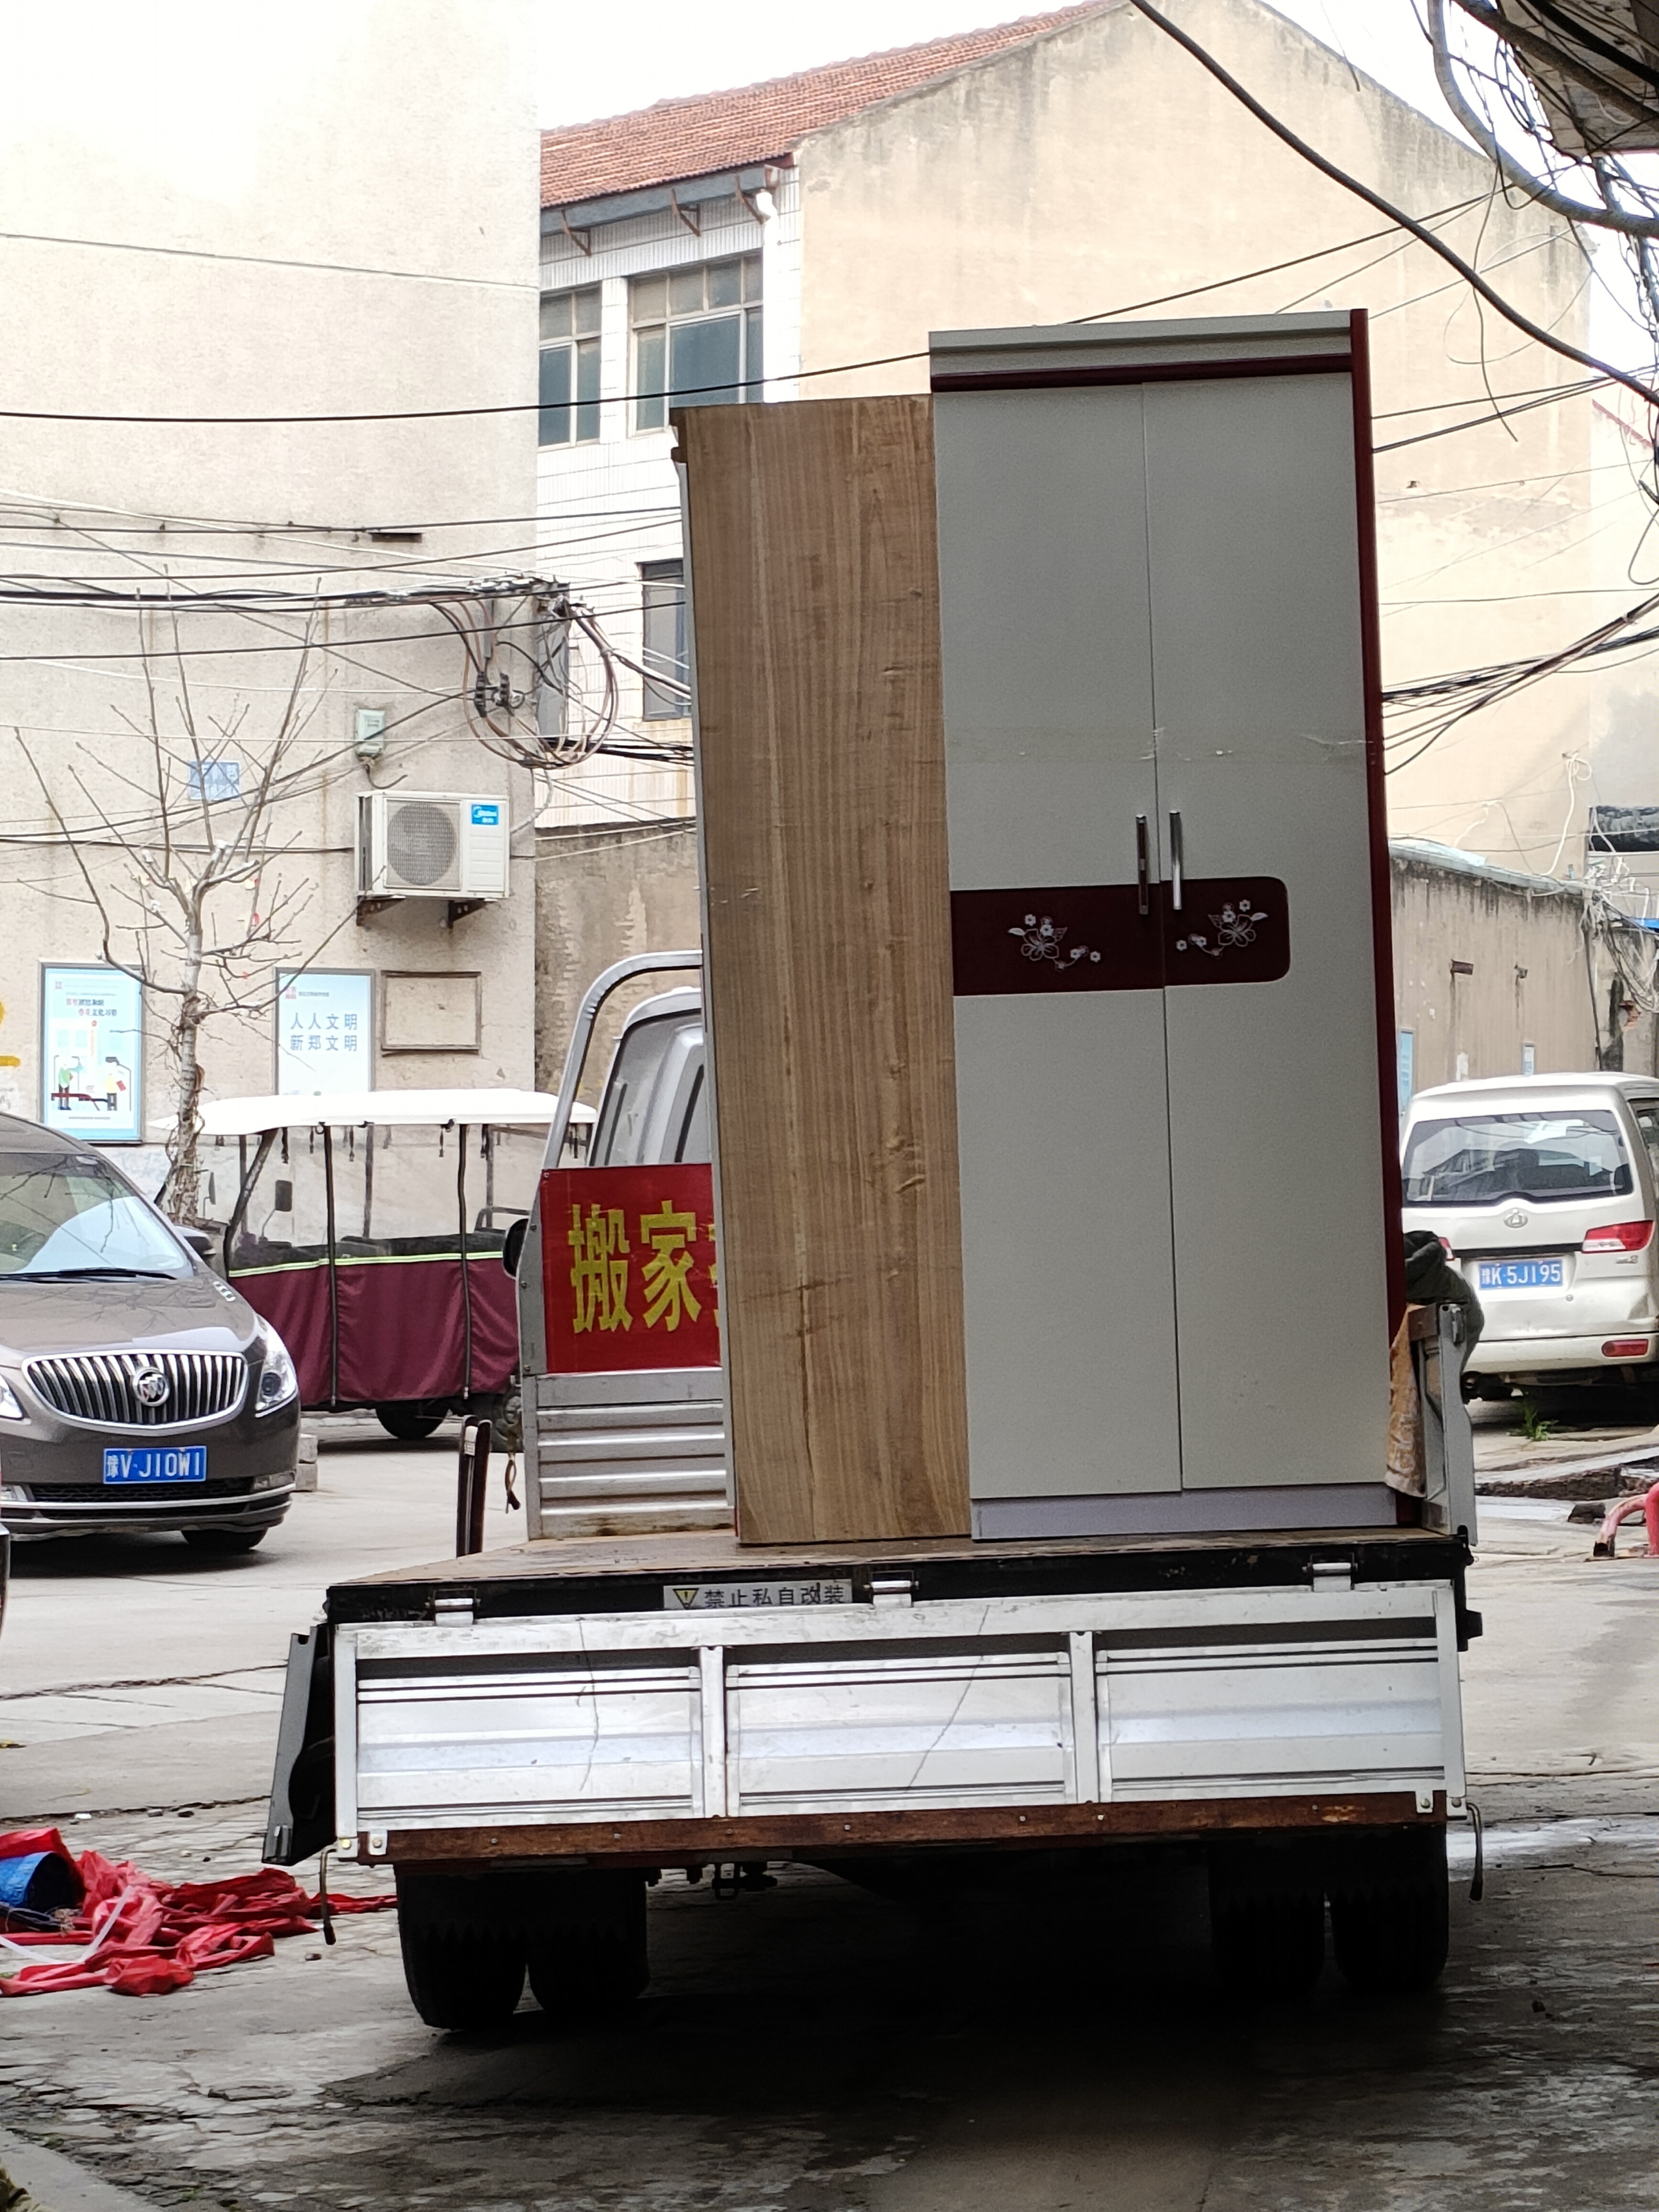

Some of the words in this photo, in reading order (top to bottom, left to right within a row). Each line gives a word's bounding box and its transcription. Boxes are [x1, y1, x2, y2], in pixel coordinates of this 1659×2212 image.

[290, 1012, 357, 1030] 人人文明
[290, 1034, 357, 1051] 新郑文明
[568, 1200, 718, 1334] 搬家
[705, 1582, 845, 1608] 禁止私自改装
